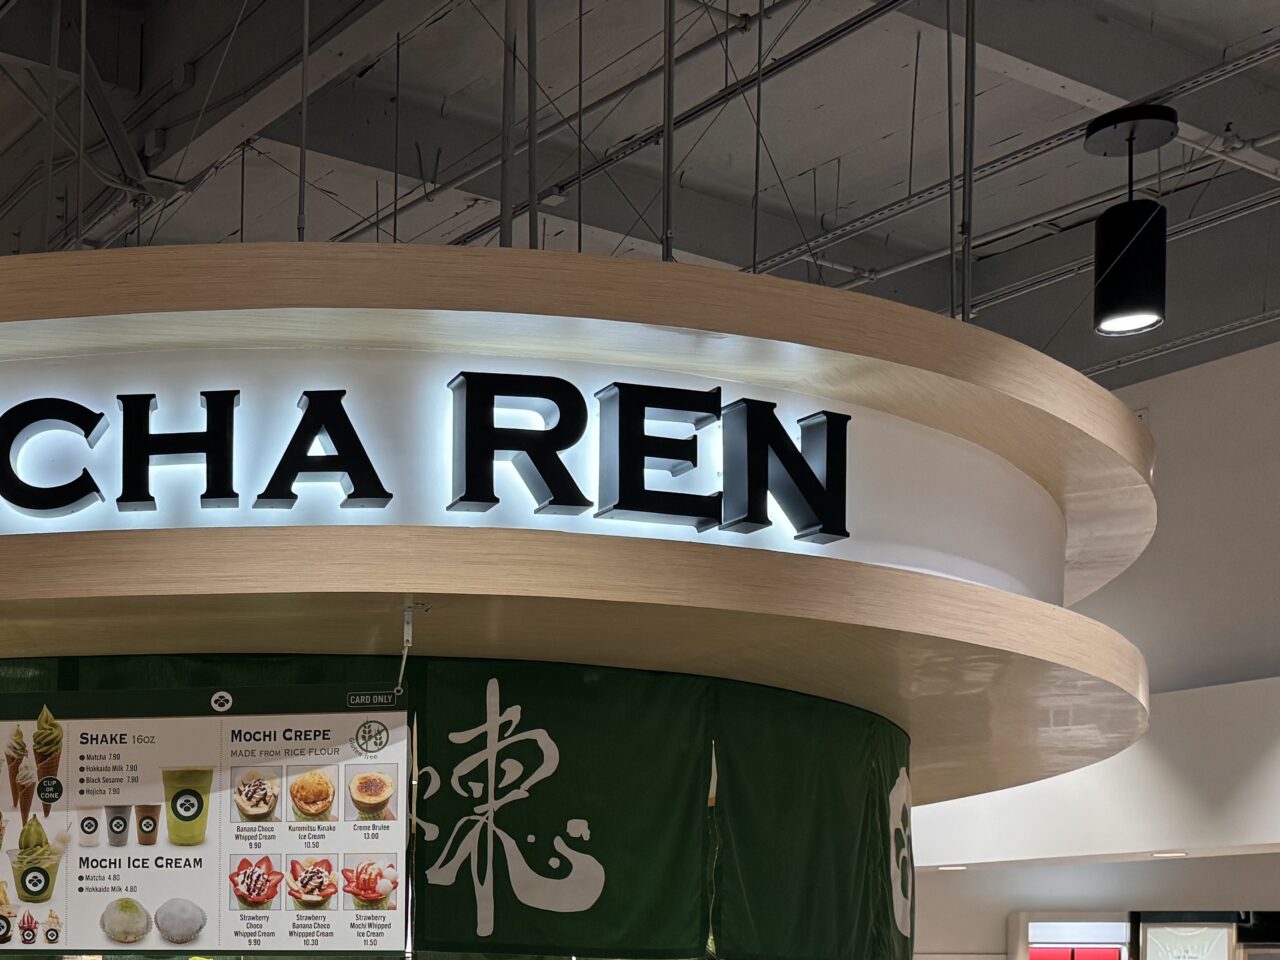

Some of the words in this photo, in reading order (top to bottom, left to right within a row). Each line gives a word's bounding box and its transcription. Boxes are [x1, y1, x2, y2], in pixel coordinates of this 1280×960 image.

[444, 371, 851, 544] REN
[349, 695, 371, 704] CARD
[372, 695, 393, 704] ONLY
[79, 732, 128, 745] SHAKE
[231, 729, 277, 742] MOCHI
[282, 728, 331, 741] CREPE
[230, 750, 256, 758] MADE
[284, 748, 306, 756] RICE
[308, 748, 340, 756] FLOUR
[86, 788, 106, 796] Hojicha
[234, 834, 258, 842] Whipped
[364, 832, 379, 840] 13.00
[79, 856, 122, 869] MOCHI
[128, 856, 150, 868] ICE
[154, 856, 203, 868] CREAM
[239, 914, 269, 922] Strawberry
[296, 914, 326, 922] Strawberry
[356, 914, 386, 922] Strawberry
[367, 922, 392, 930] Whipped
